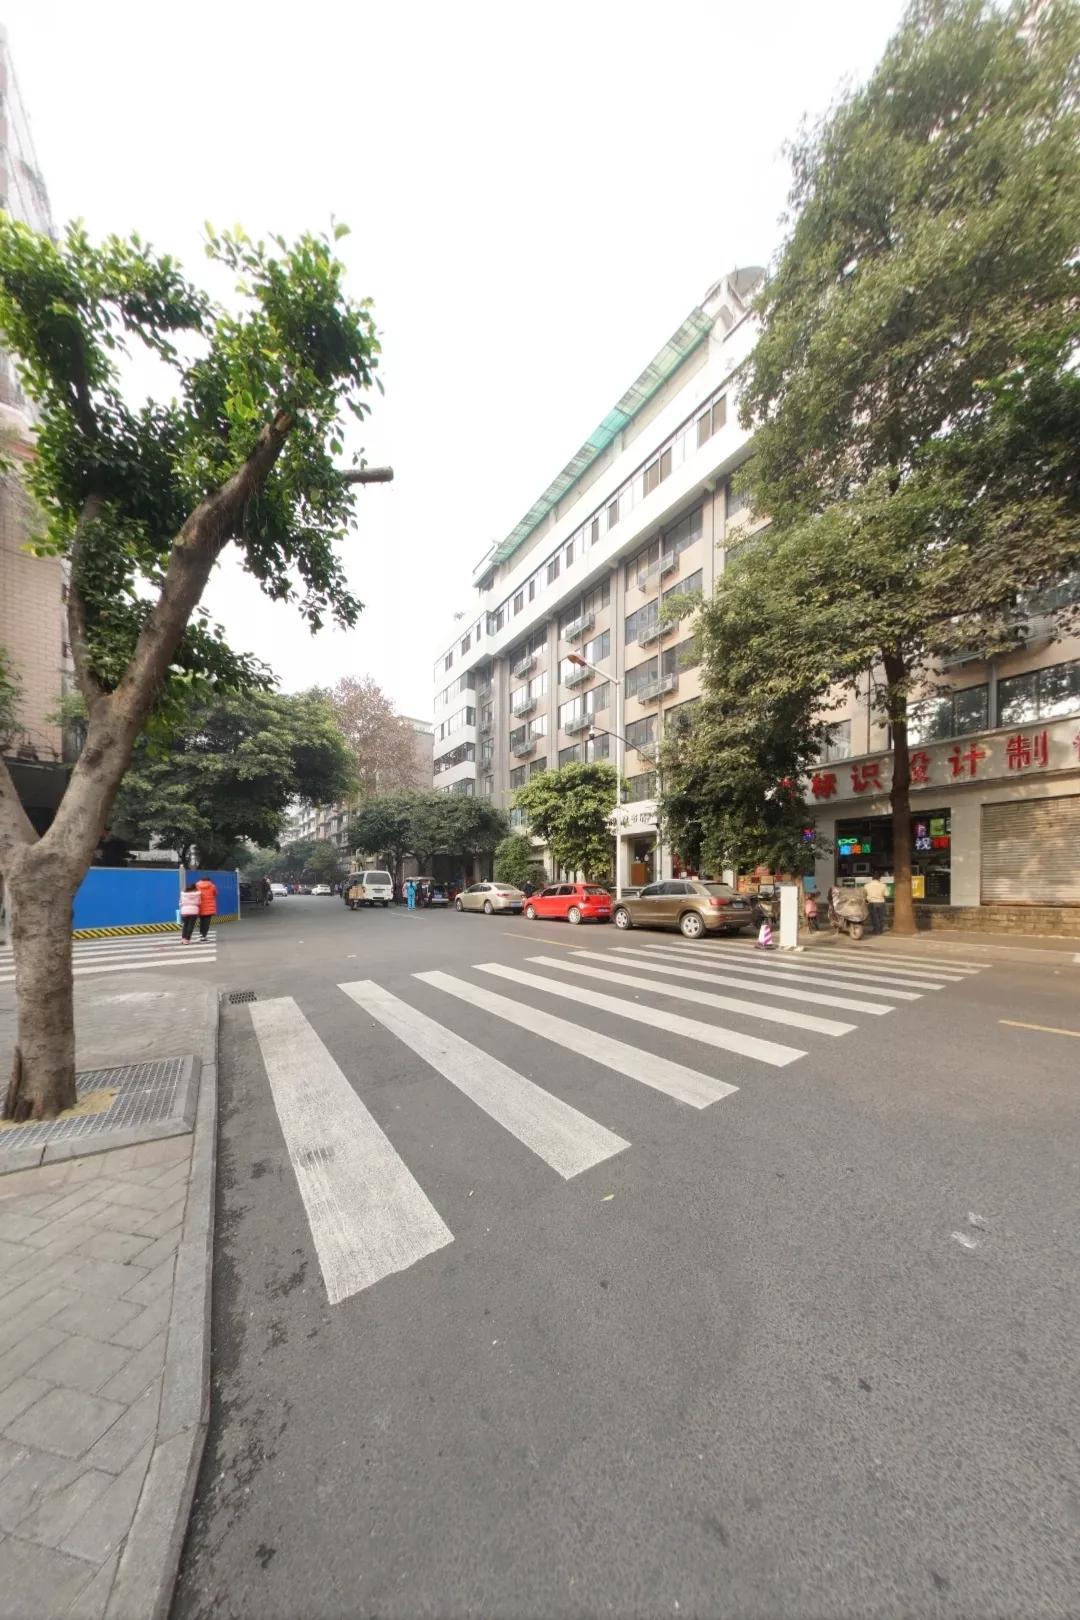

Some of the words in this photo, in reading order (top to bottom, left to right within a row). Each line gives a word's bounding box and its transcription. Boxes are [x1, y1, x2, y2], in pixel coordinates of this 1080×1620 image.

[811, 730, 1080, 800] 标识设计制
